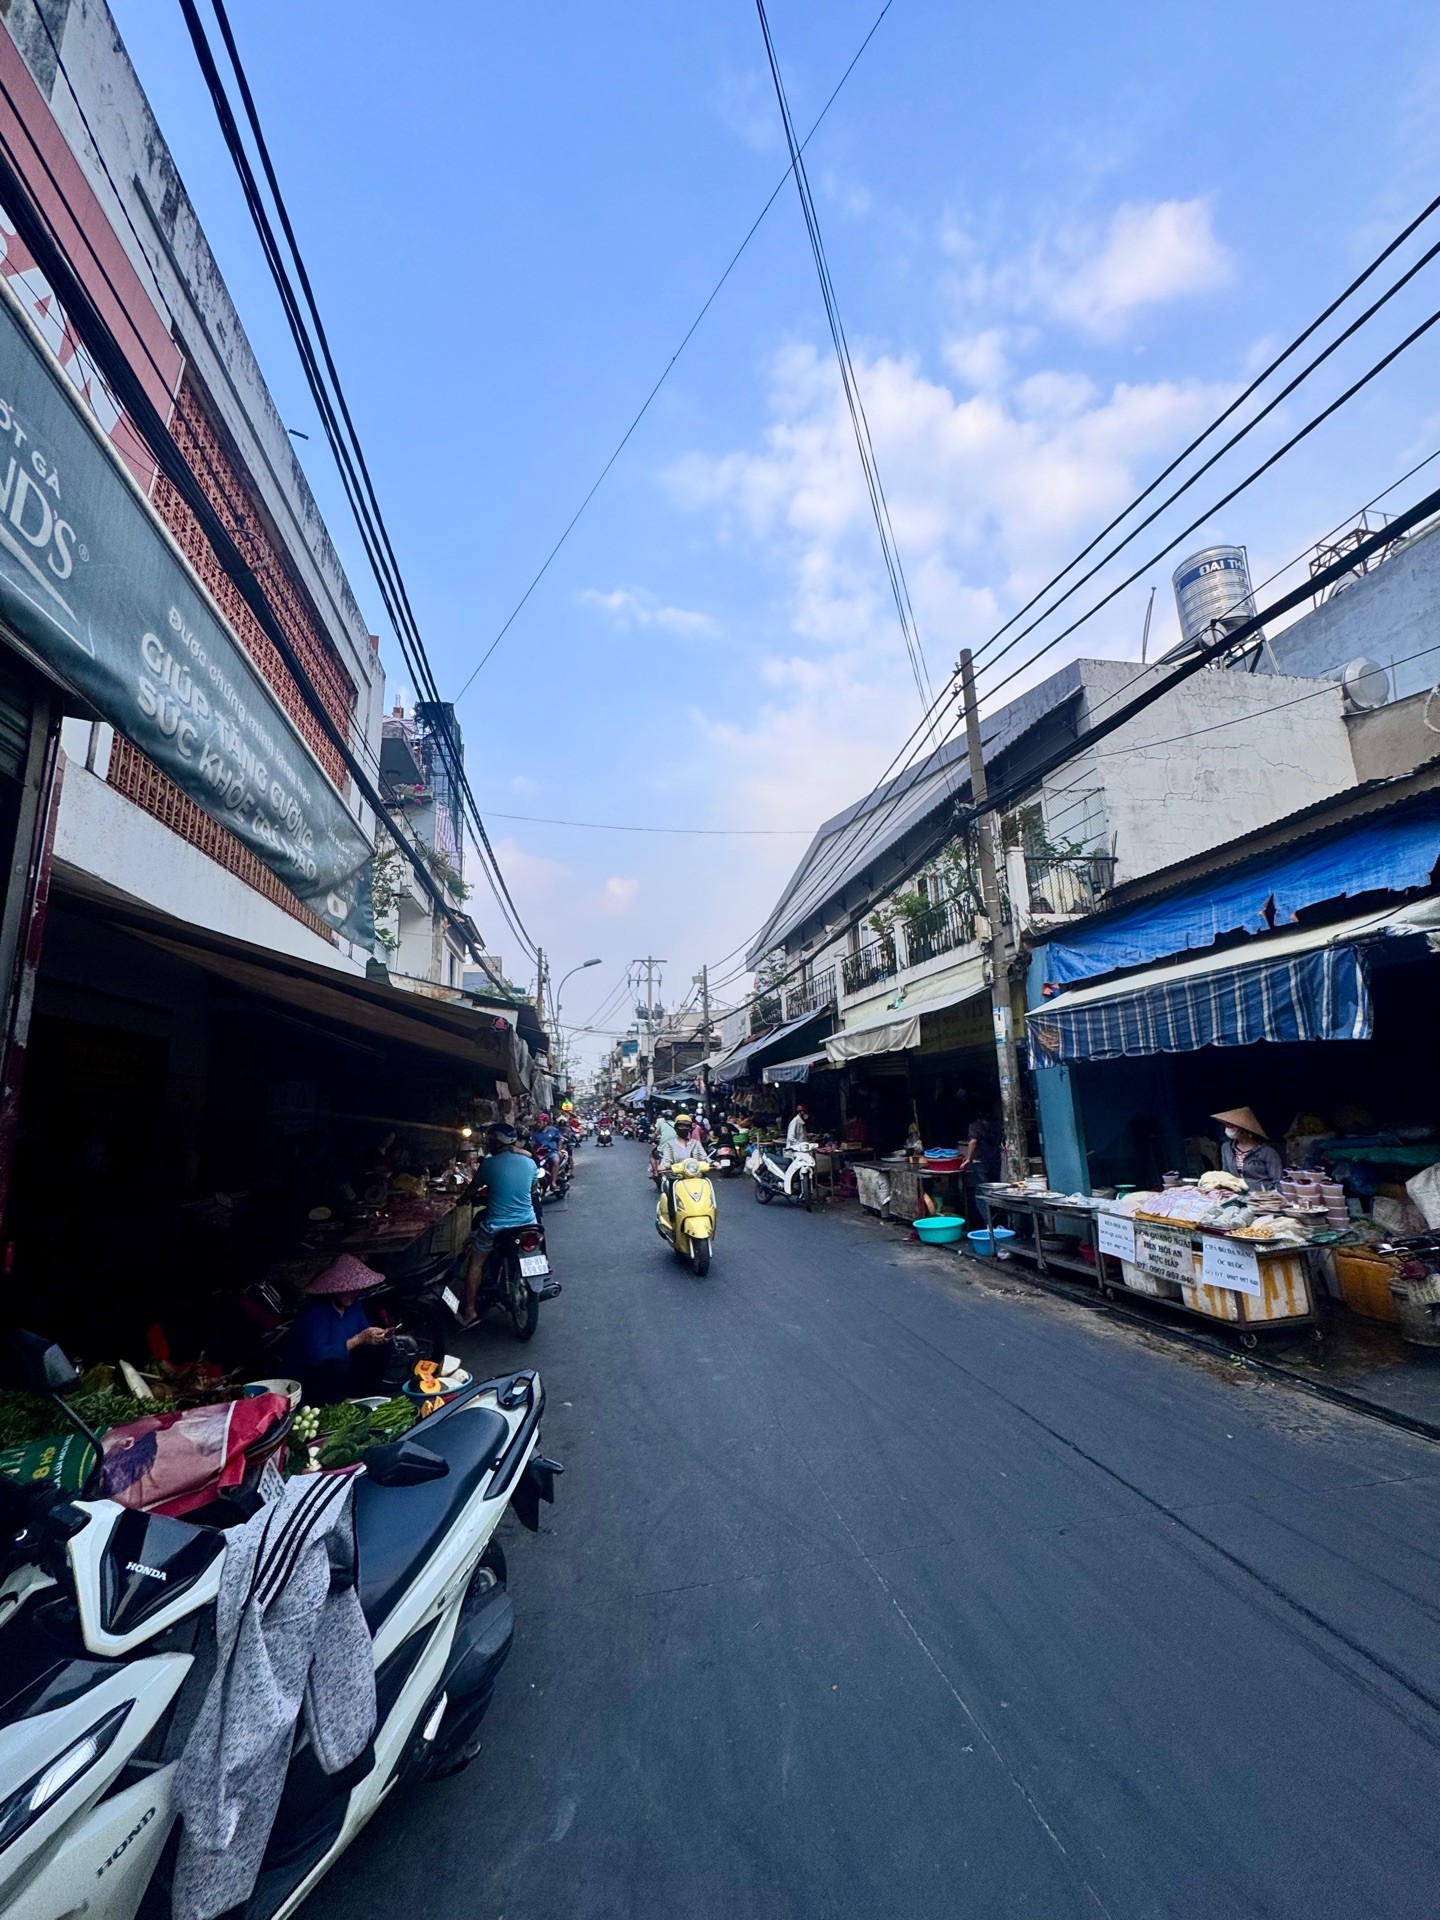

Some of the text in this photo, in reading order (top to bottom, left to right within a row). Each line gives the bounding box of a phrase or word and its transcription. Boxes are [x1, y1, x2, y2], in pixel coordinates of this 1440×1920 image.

[31, 450, 61, 500] GÀ
[137, 674, 198, 760] SỨC
[198, 742, 256, 823] KHỎE
[141, 631, 211, 719] GIÚP
[214, 708, 269, 793] TĂNG
[168, 605, 207, 668] Được
[208, 665, 247, 723] chứng
[247, 716, 275, 757] minh
[125, 1561, 168, 1581] HONDA
